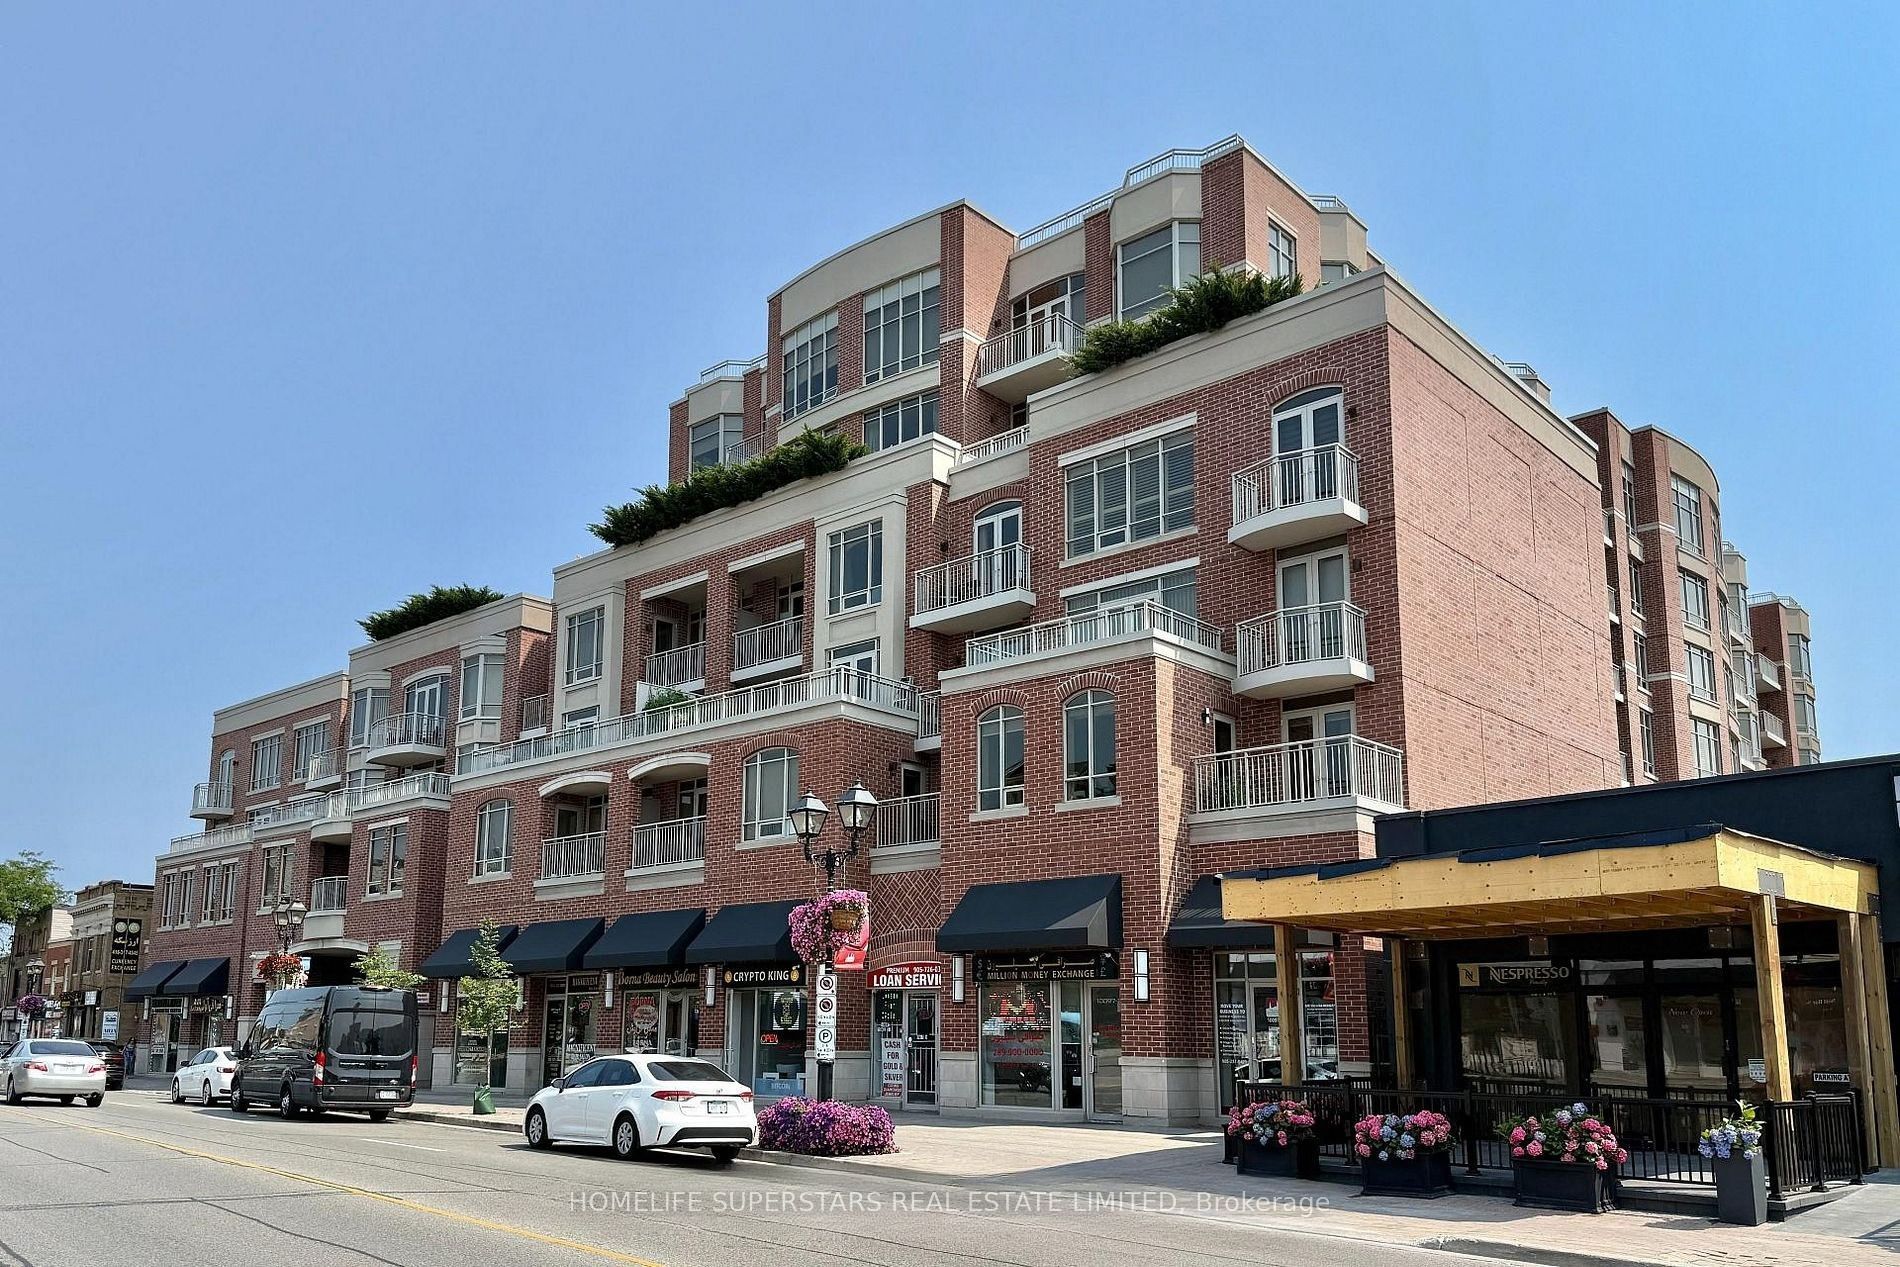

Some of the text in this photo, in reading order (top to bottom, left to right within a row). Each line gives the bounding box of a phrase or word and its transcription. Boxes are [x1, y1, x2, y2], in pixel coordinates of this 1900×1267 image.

[643, 971, 671, 987] Beauty
[672, 968, 696, 984] Salon
[733, 970, 789, 982] CRYPTO KING
[987, 969, 1095, 980] MILLION MONEY EXCHANGE
[1488, 966, 1570, 984] NESPRESSO
[873, 974, 903, 987] LOAN
[760, 1034, 779, 1043] OPEN
[884, 1041, 901, 1049] CASH
[886, 1052, 900, 1060] FOR
[883, 1063, 898, 1071] GOLD
[884, 1073, 904, 1081] SILVER
